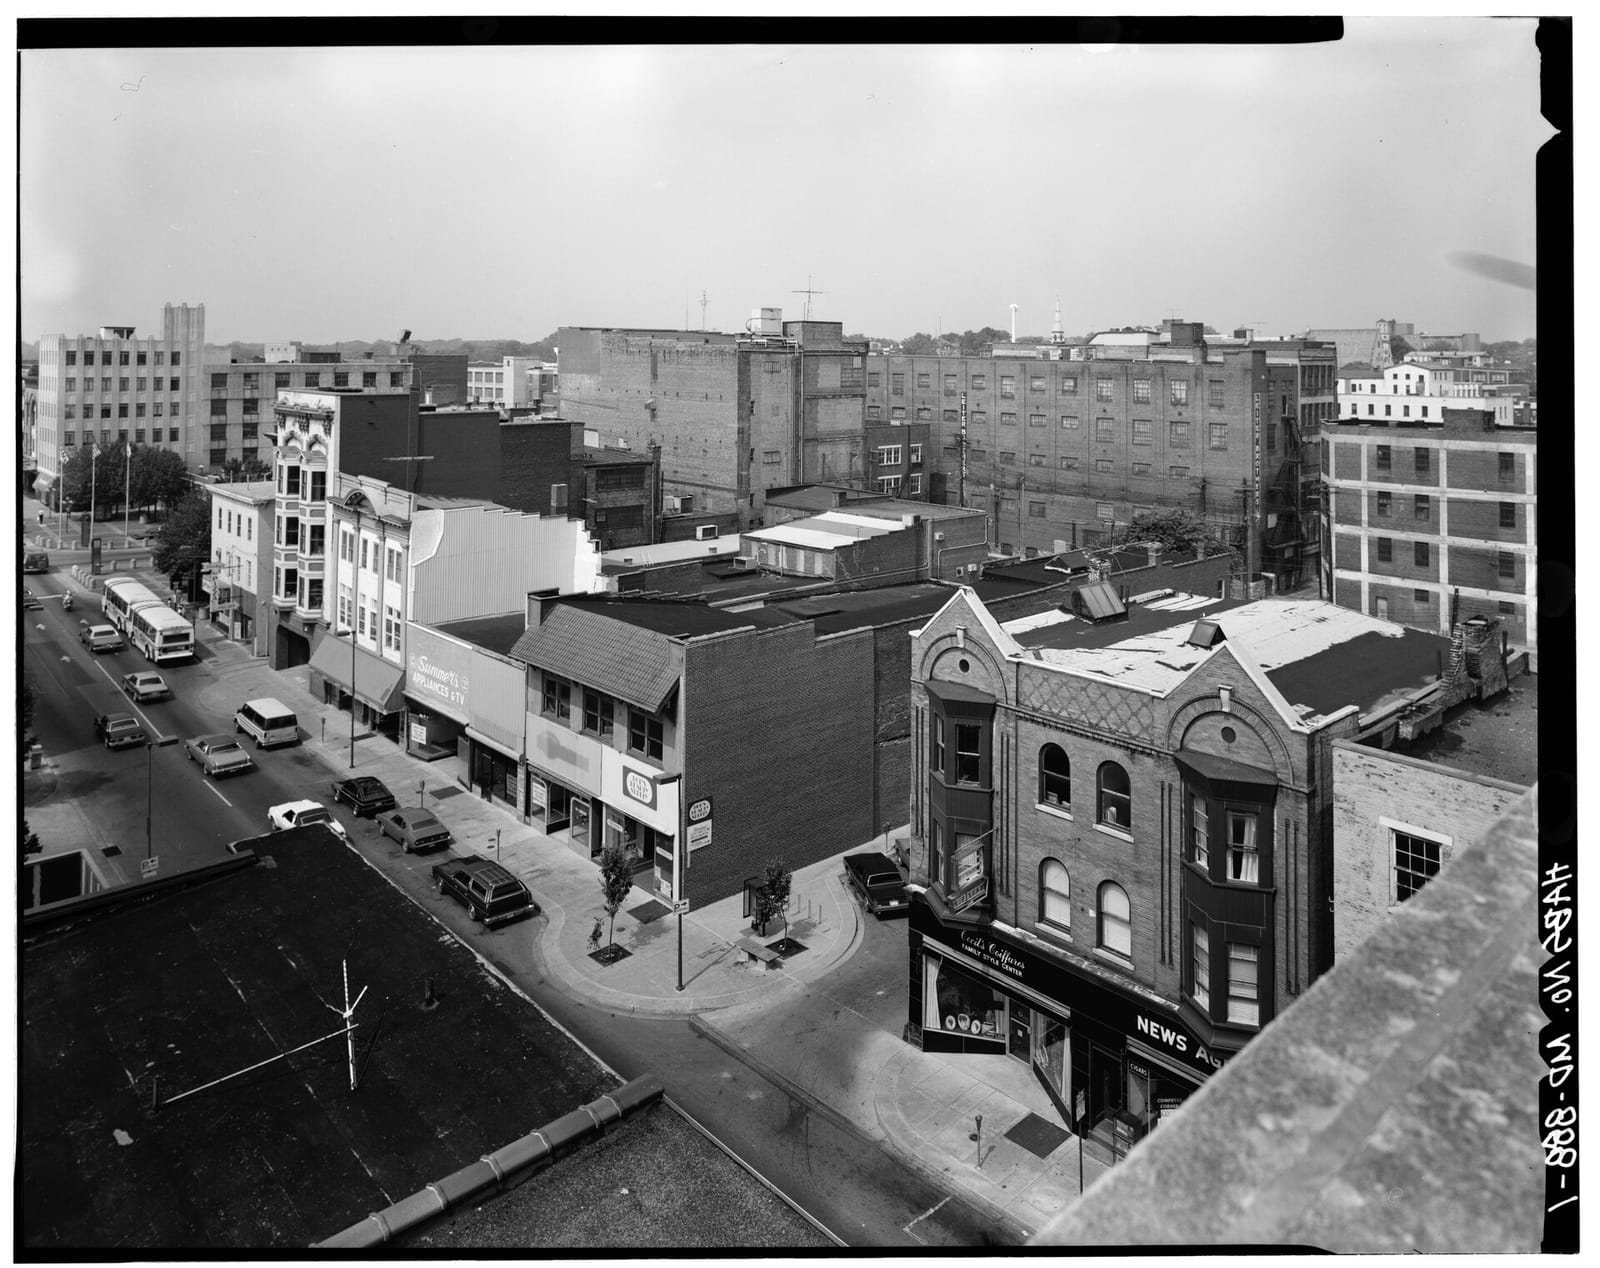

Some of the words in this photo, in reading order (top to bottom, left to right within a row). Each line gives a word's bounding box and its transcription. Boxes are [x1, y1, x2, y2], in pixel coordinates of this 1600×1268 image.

[413, 671, 449, 698] APPLIANCES
[456, 691, 465, 705] TV
[961, 943, 981, 957] FAMILY
[982, 953, 999, 967] STYLE
[1001, 963, 1023, 978] CENTER
[1137, 1015, 1187, 1051] NEWS
[1130, 1063, 1147, 1077] CIGARS
